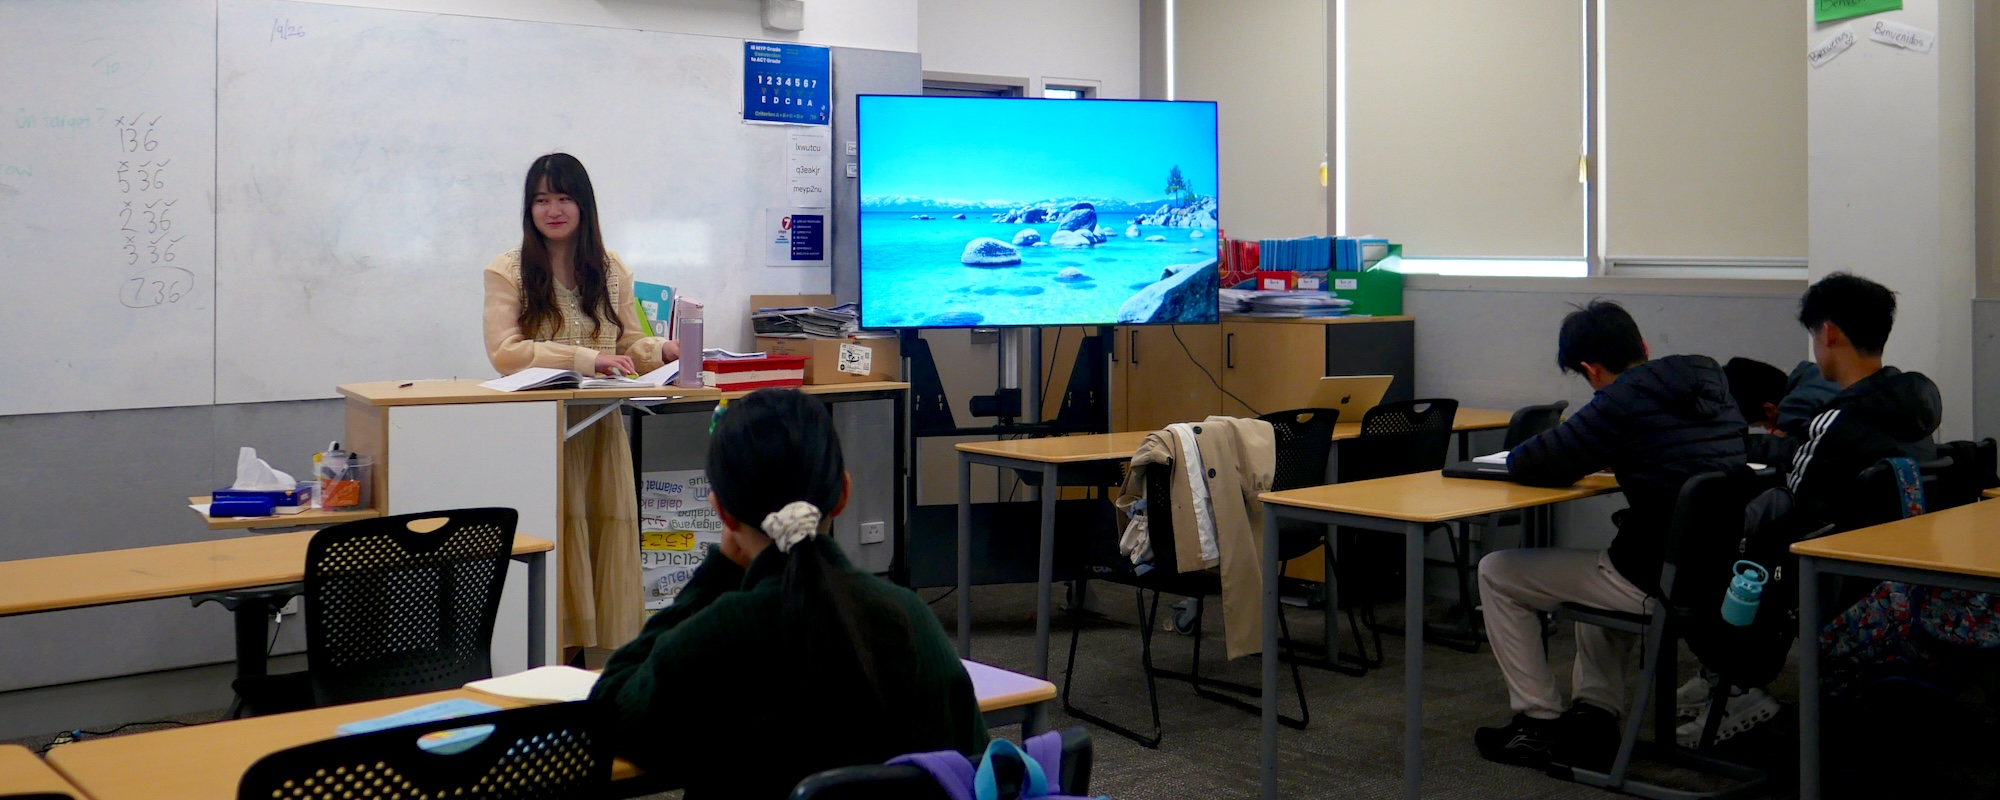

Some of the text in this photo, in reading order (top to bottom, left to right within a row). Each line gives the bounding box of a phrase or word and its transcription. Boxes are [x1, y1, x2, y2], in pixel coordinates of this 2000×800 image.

[758, 75, 817, 88] 1 2 3 4 5 6 7
[797, 98, 802, 106] B
[119, 128, 159, 153] 136
[117, 169, 164, 194] 536
[119, 208, 171, 234] 236
[123, 243, 175, 266] 336
[130, 277, 180, 305] 736
[646, 479, 683, 494] selamat
[657, 497, 683, 510] dalal
[671, 519, 722, 531] aligayang
